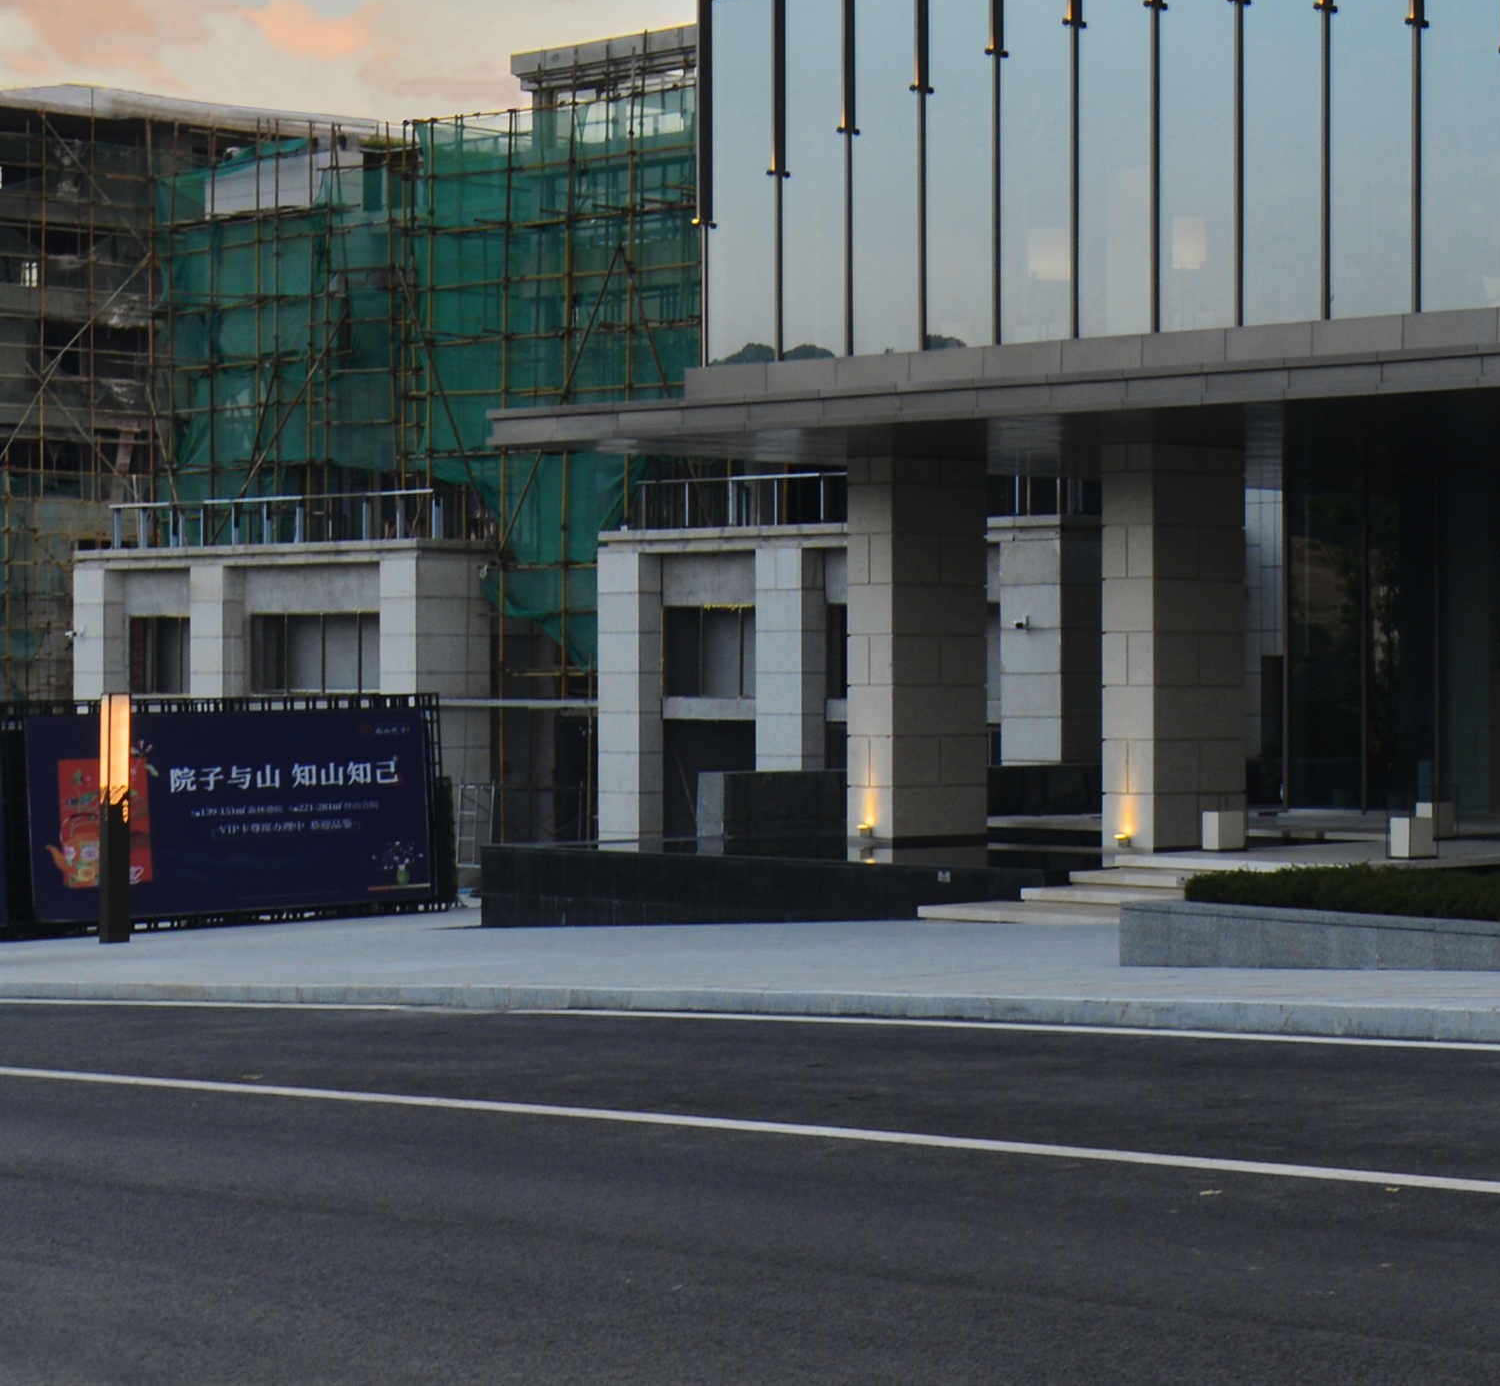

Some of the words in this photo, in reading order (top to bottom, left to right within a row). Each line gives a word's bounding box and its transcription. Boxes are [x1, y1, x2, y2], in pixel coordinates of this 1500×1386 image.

[169, 764, 281, 794] 院子与山
[292, 760, 399, 789] 知山知己
